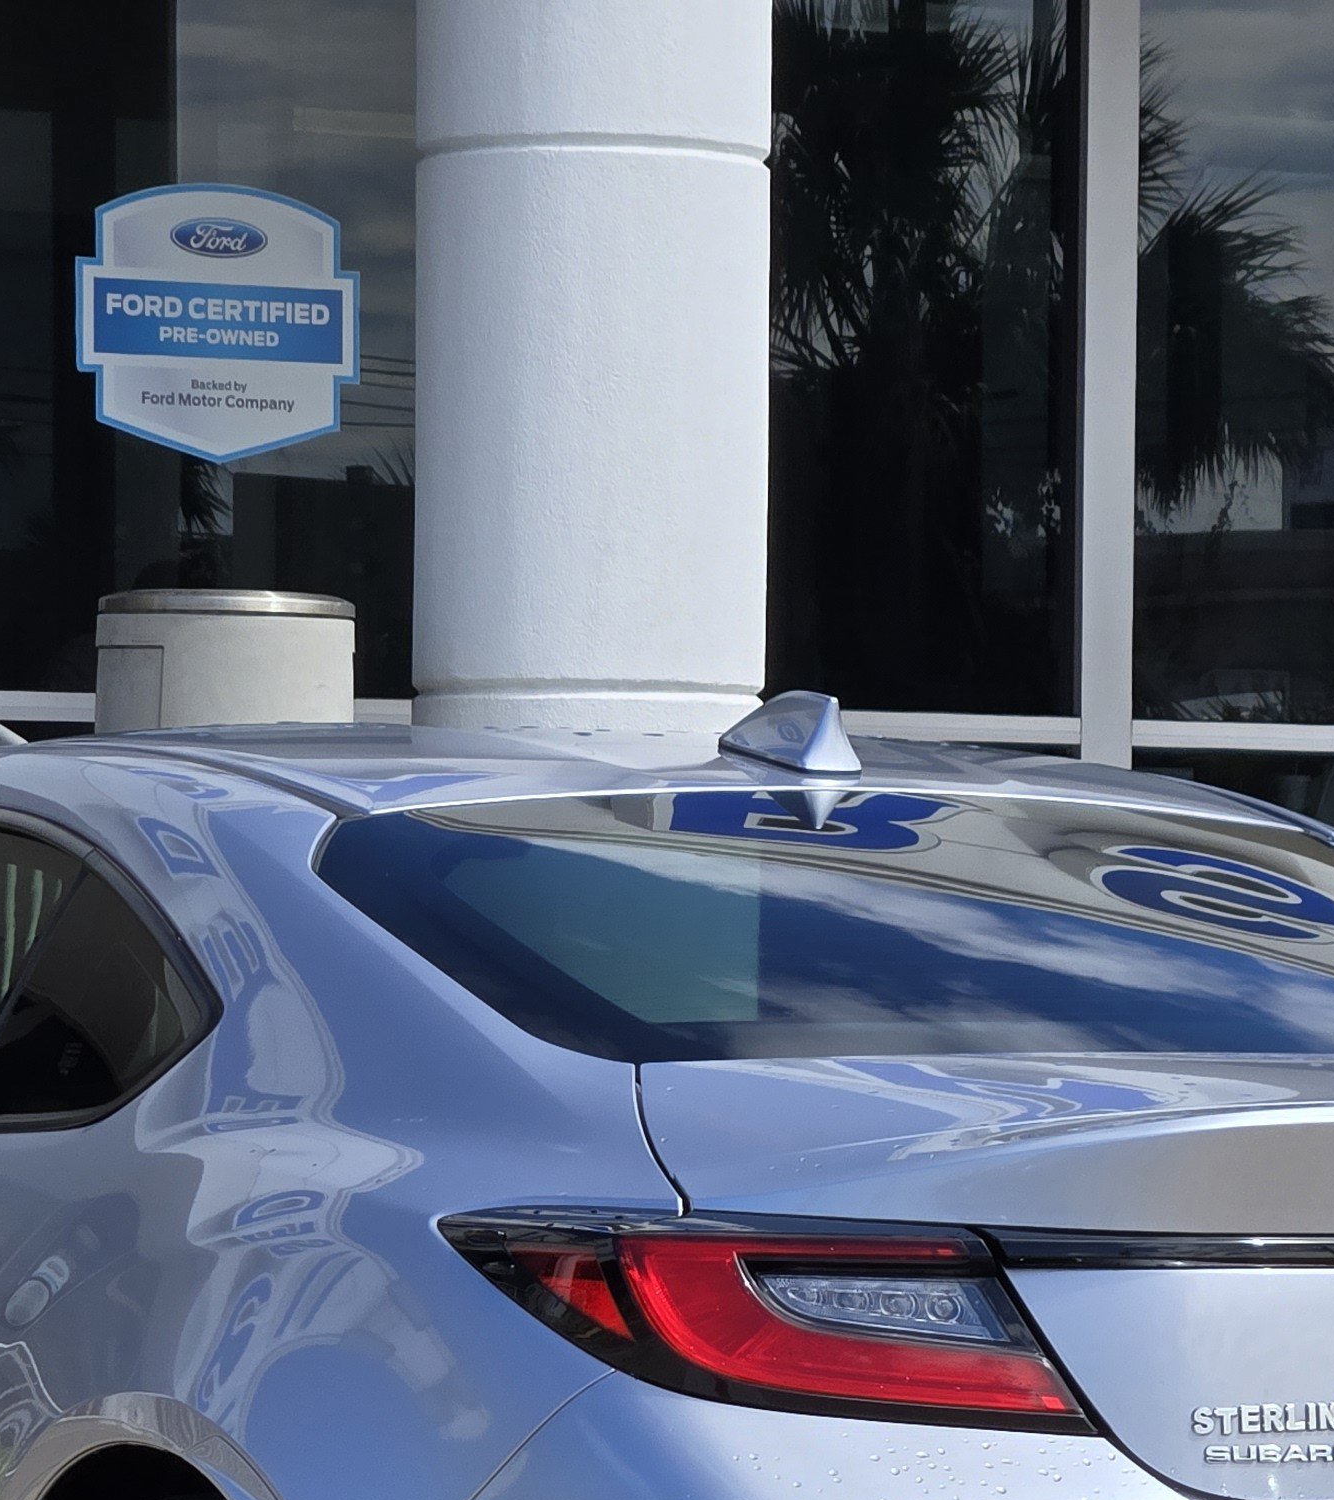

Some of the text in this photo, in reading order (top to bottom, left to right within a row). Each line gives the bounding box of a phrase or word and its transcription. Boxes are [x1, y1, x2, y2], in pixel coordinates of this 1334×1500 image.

[190, 224, 248, 252] Ford
[106, 293, 330, 325] FORD CERTIFIED
[159, 327, 279, 347] PRE-OWNED
[191, 379, 247, 393] Backed by
[141, 390, 295, 413] Ford Motor Company
